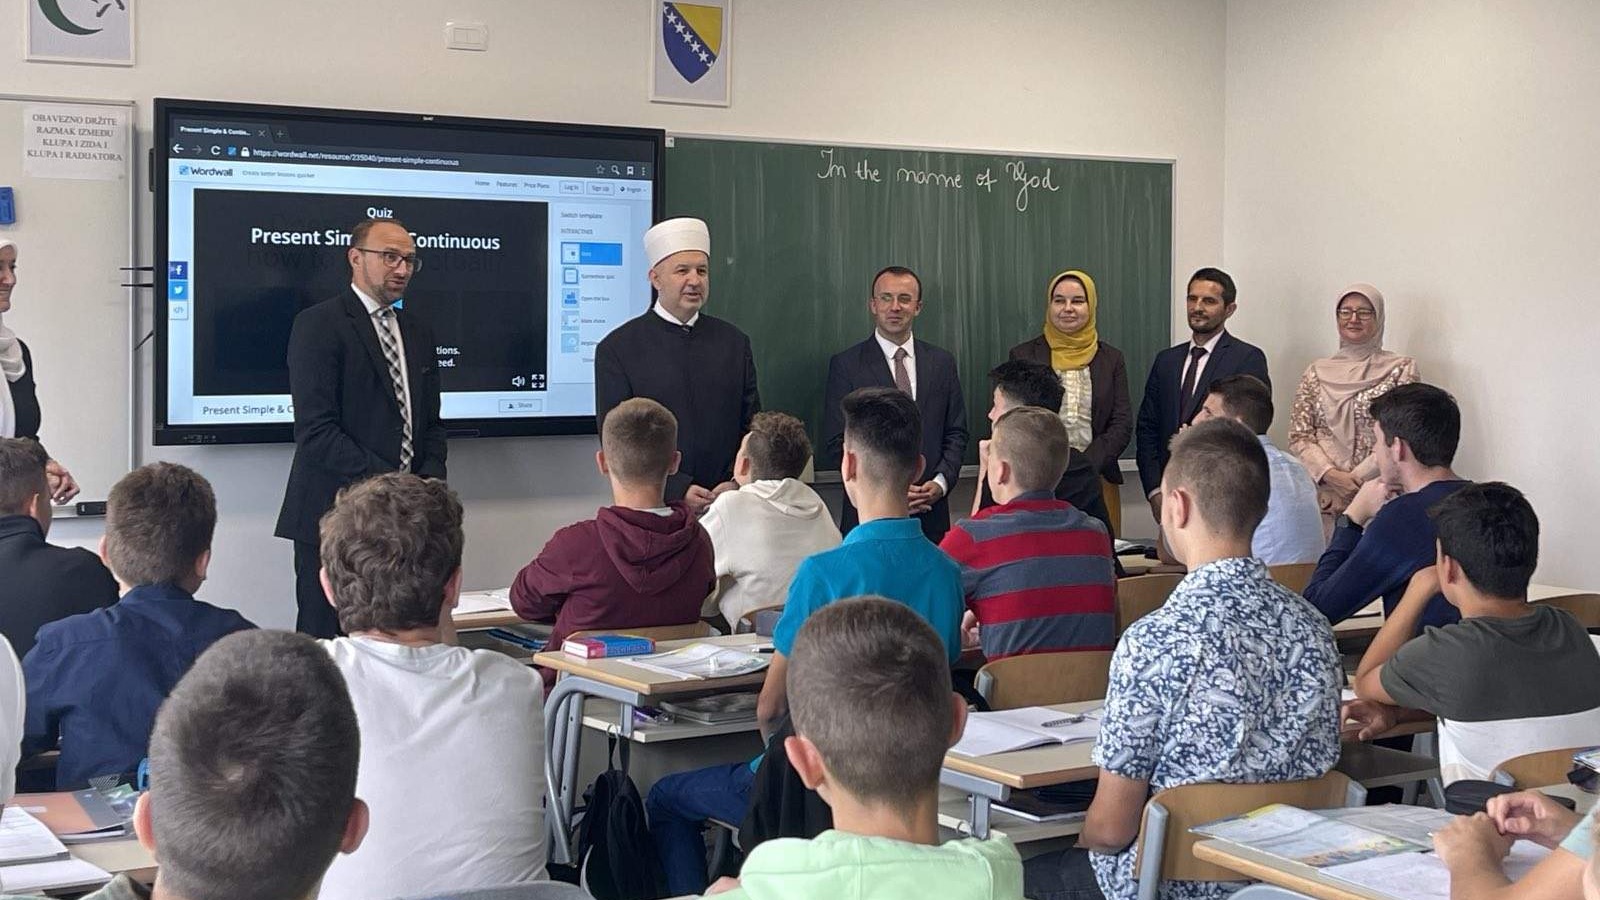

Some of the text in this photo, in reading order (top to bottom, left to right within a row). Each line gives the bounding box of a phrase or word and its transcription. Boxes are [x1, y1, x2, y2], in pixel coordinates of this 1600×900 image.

[32, 114, 83, 124] OBAVEZNO
[36, 126, 76, 136] RAZMAK
[42, 138, 73, 148] KLUPA
[80, 140, 102, 149] ZIDA
[27, 149, 58, 159] KLUPA
[855, 159, 882, 183] the
[896, 167, 963, 189] name
[976, 168, 998, 193] of
[1005, 160, 1060, 212] God
[366, 206, 394, 220] Quiz
[251, 227, 323, 246] Present
[324, 229, 354, 247] Sim
[436, 345, 460, 355] tions.
[437, 357, 456, 367] eed.
[202, 406, 241, 416] Present
[242, 405, 275, 416] Simple
[277, 405, 284, 414] &
